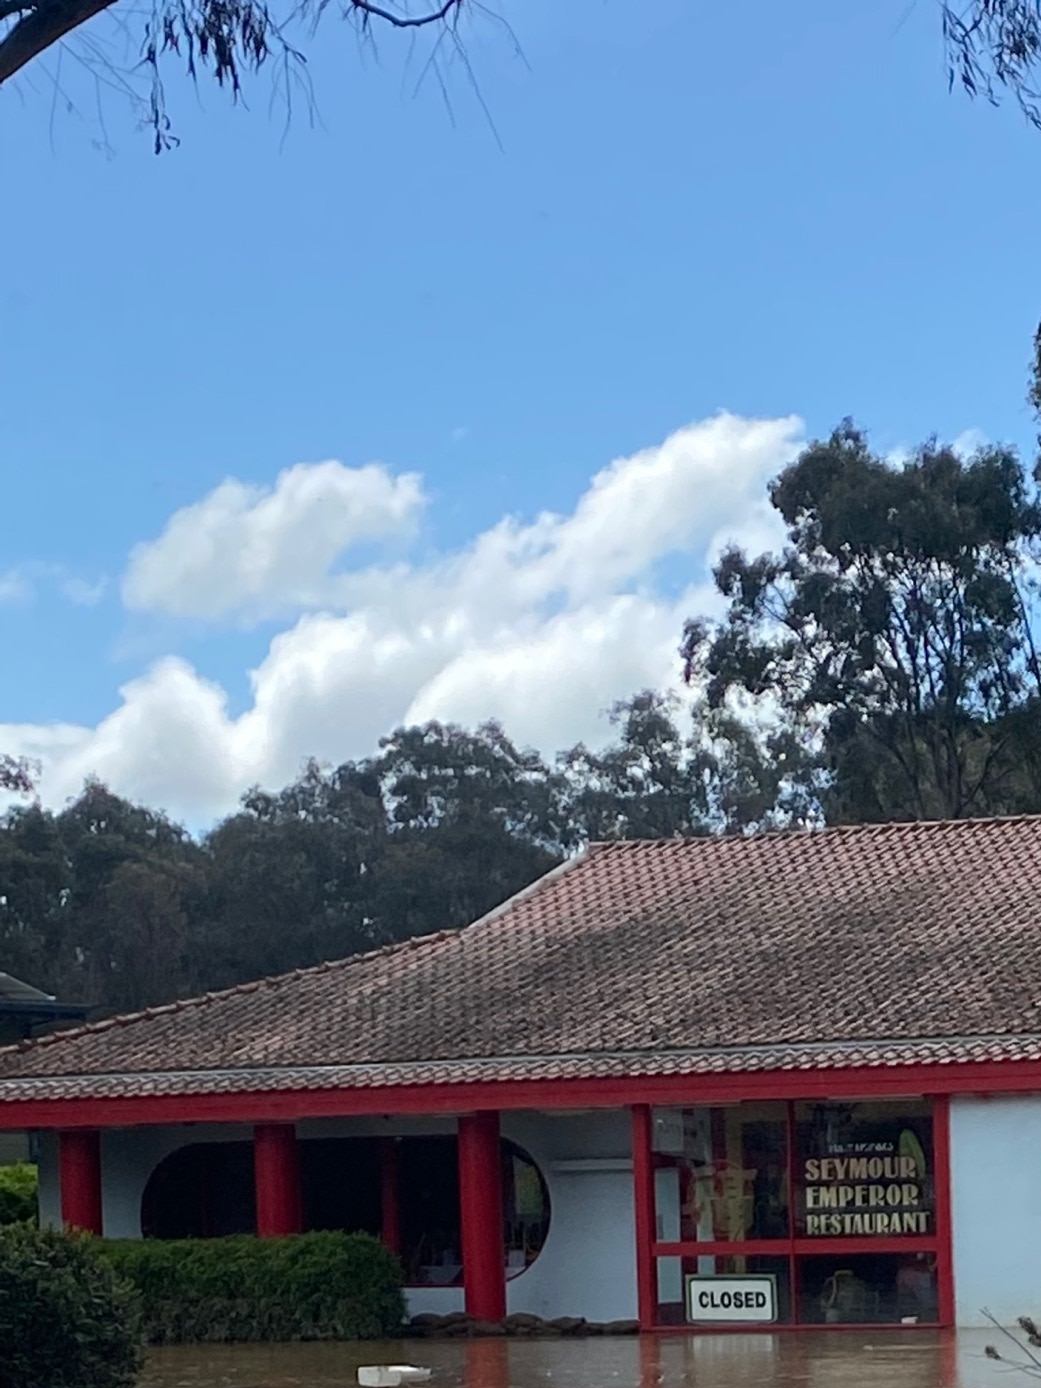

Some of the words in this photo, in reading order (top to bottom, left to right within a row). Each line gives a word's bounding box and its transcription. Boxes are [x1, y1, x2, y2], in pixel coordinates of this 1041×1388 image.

[805, 1156, 917, 1181] SEYMOUR
[805, 1183, 919, 1208] EMPEROR
[806, 1211, 930, 1235] RESTAURANT
[698, 1291, 766, 1308] CLOSED
